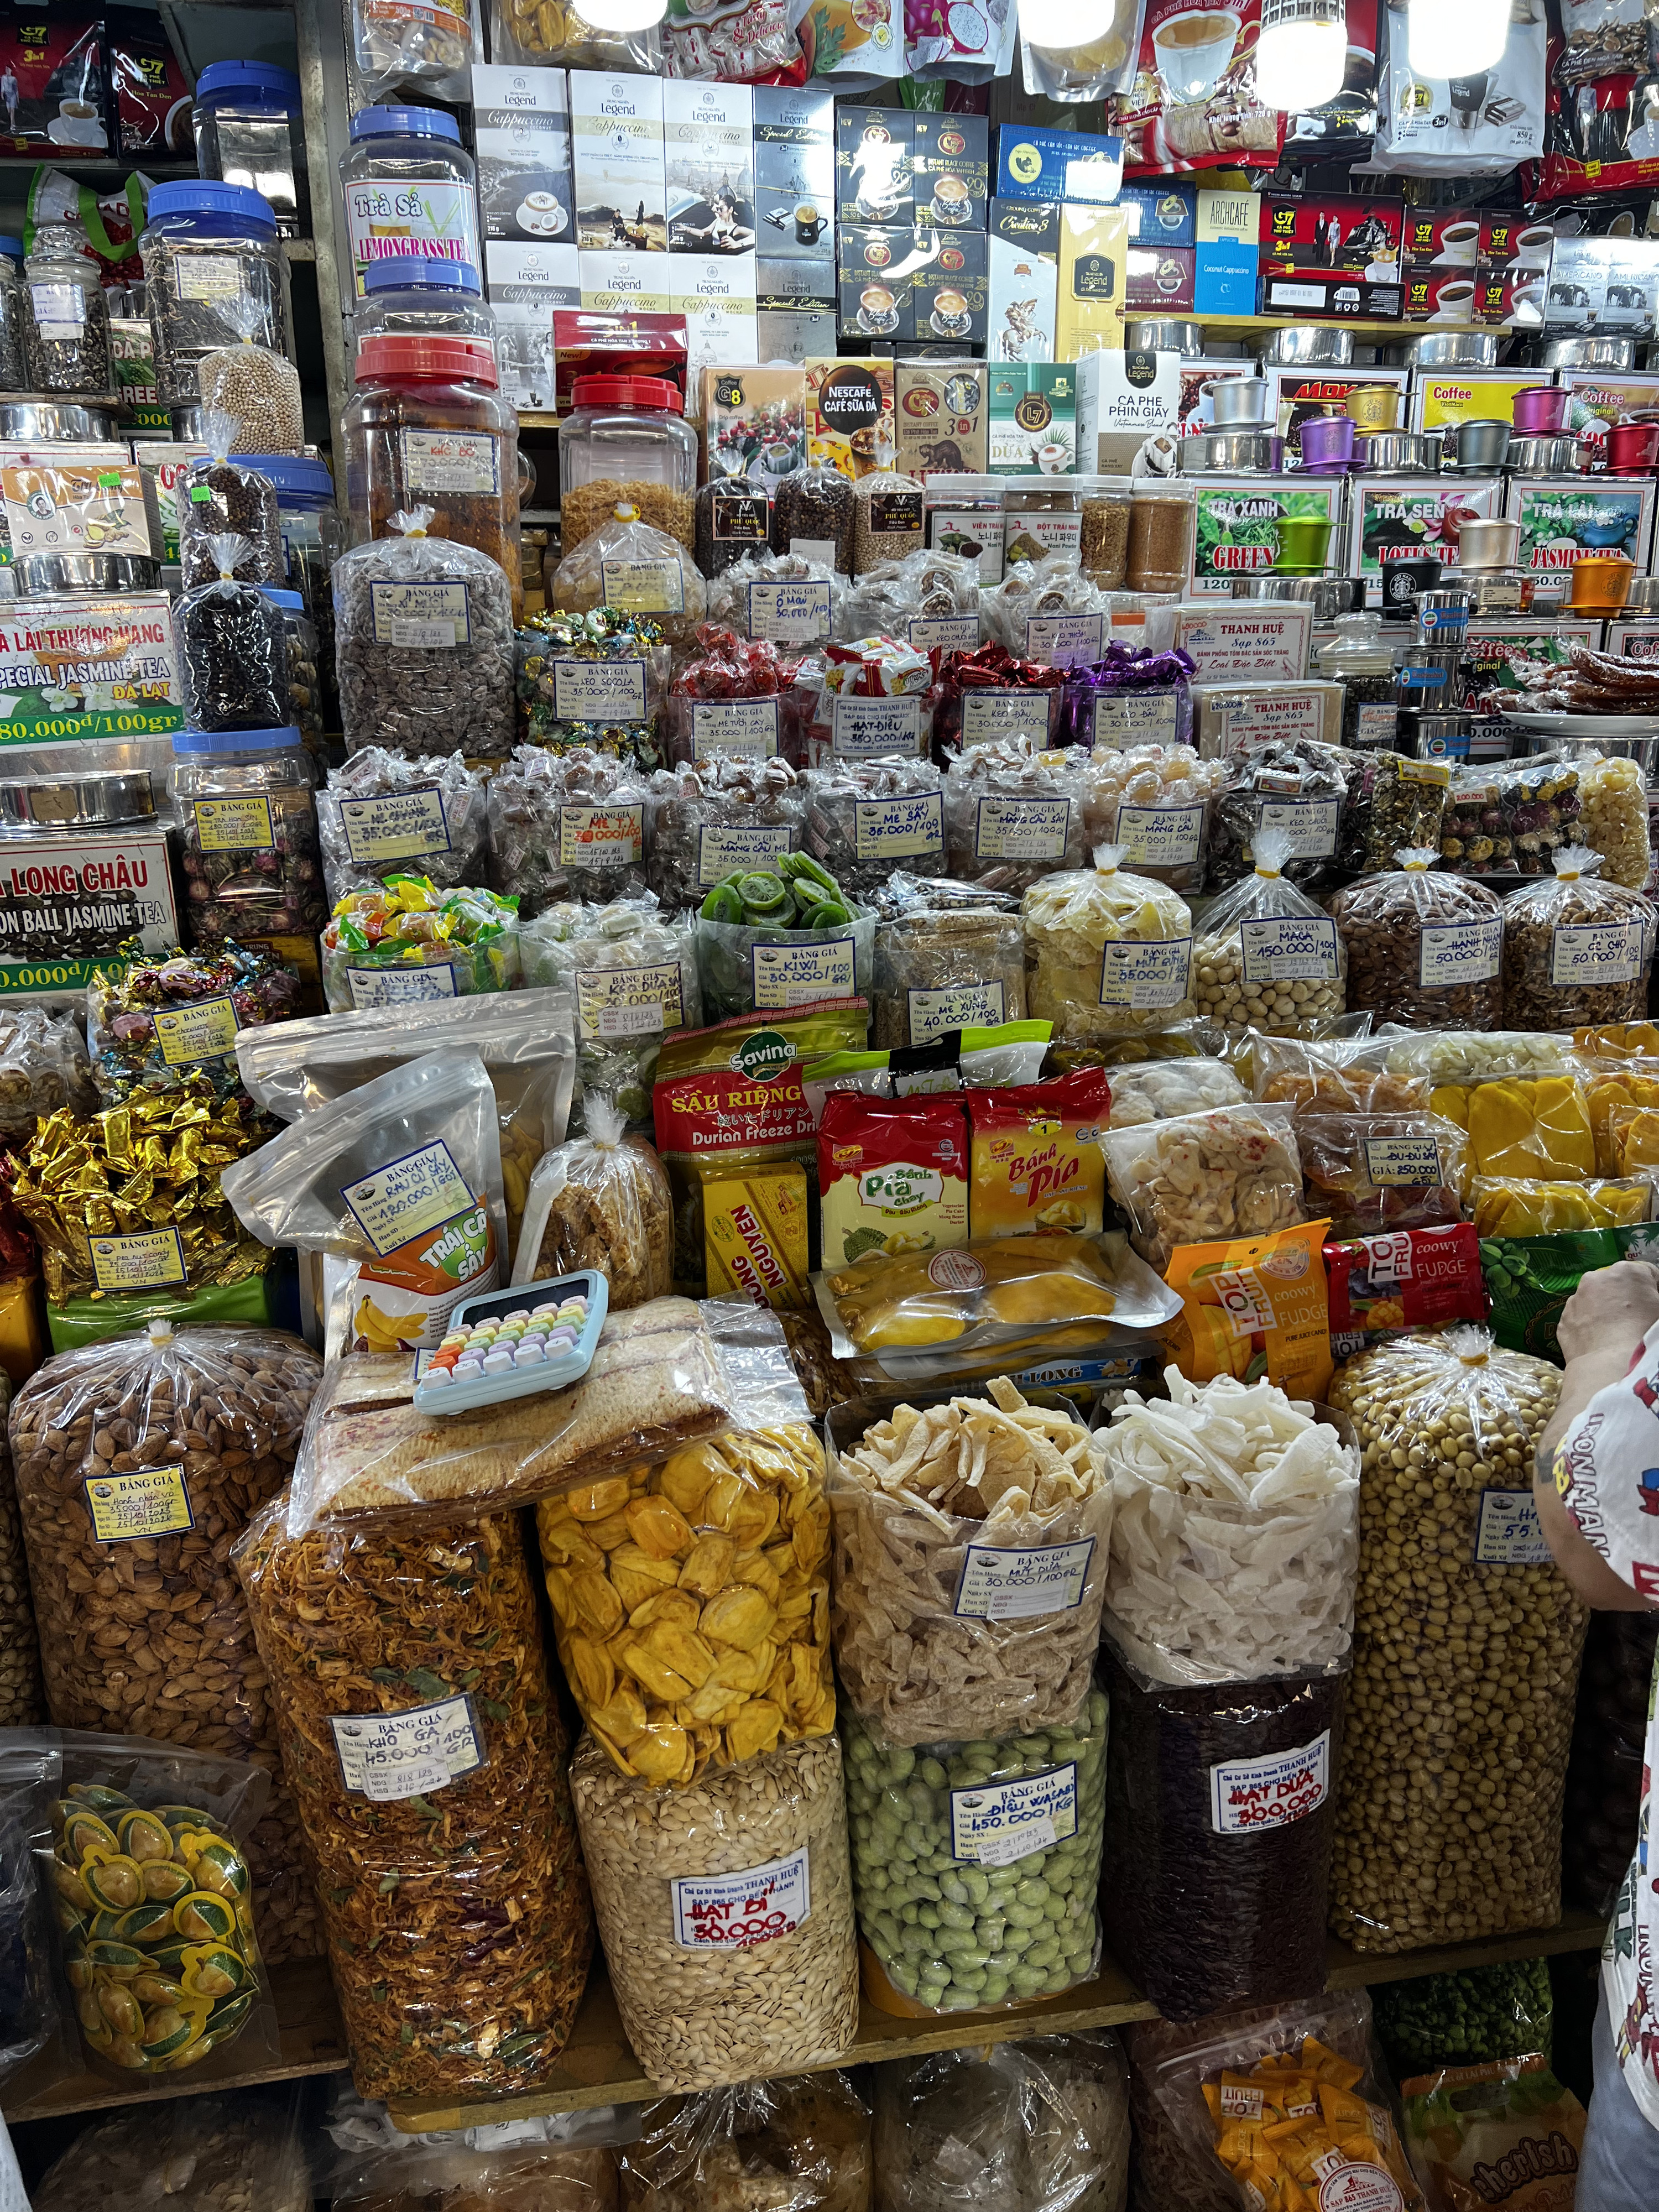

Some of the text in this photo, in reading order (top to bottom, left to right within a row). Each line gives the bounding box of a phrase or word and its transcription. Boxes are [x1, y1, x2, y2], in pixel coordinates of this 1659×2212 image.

[741, 3, 766, 28] Tasty
[732, 21, 786, 45] & Delicious
[504, 95, 537, 107] Legend
[601, 104, 635, 116] Legend
[692, 111, 726, 123] Legend
[487, 110, 553, 128] Cappuccino
[780, 115, 808, 125] Legend
[354, 191, 422, 218] Trà Sả
[1209, 199, 1249, 228] ARCHCAFÉ
[358, 237, 472, 262] LEMONGRASS TEA
[518, 271, 549, 284] Legend
[1203, 263, 1250, 276] Coconut Cappuccino
[1557, 270, 1603, 279] AMERICANO
[608, 279, 641, 292] Legend
[696, 283, 729, 296] Legend
[782, 284, 811, 295] Legend
[1081, 275, 1108, 288] Legend
[503, 285, 567, 306] Cappuccino
[593, 292, 656, 312] Cappuccino
[681, 296, 743, 316] Cappuccino
[560, 351, 583, 359] New!
[1128, 369, 1154, 379] Legend
[718, 385, 741, 405] G8
[828, 383, 873, 399] NESCAFÉ
[1433, 387, 1472, 400] Coffee
[1580, 389, 1624, 405] Coffee
[825, 398, 877, 413] CAFÉ SỮA ĐÁ
[1109, 406, 1139, 416] PHIN
[1026, 407, 1042, 423] L7
[945, 418, 955, 436] 3
[959, 422, 968, 431] in
[1240, 501, 1278, 517] XANH
[1409, 504, 1446, 519] SEN
[1052, 522, 1069, 530] TRÁI
[1213, 546, 1275, 570] GREEN
[1221, 622, 1284, 635] THANH HUỆ
[14, 623, 164, 652] LÀI THƯỢNG HẠNG
[1232, 638, 1276, 648] Sạp 865
[588, 666, 629, 675] BẢNG GIÁ
[1208, 660, 1229, 670] Loại
[58, 657, 171, 690] JASMINE TEA
[113, 682, 170, 701] ĐÀ LẠT
[1255, 699, 1312, 713] THANH HUỆ
[1264, 713, 1281, 723] Sạp
[375, 796, 424, 812] BẢNG GIÁ
[1455, 792, 1485, 802] 200.000
[221, 800, 262, 811] BẢNG GIÁ
[884, 815, 900, 824] ME
[11, 854, 149, 895] LONG CHÂU
[23, 900, 166, 936] BALL JASMINE TEA
[1279, 932, 1314, 942] MACA
[791, 947, 838, 961] BẢNG GIÁ
[784, 960, 818, 972] KIWI
[939, 1005, 953, 1015] ME
[729, 1041, 797, 1072] Savina
[671, 1085, 802, 1113] SẦU RIÊNG
[692, 1124, 793, 1145] Durian Freeze
[386, 1152, 433, 1184] BẢNG GIÁ
[1007, 1141, 1057, 1183] Bánh
[894, 1168, 933, 1180] Bánh
[1027, 1156, 1079, 1208] Pía
[121, 1233, 170, 1249] BẢNG GIÁ
[419, 1222, 463, 1270] TRÁI
[1416, 1239, 1461, 1254] coowy
[457, 1244, 487, 1282] SẤY
[1417, 1259, 1467, 1277] FUDGE
[1224, 1275, 1251, 1329] TOP
[1274, 1285, 1318, 1304] coowy
[1279, 1303, 1328, 1327] FUDGE
[1044, 1365, 1083, 1383] LONG
[119, 1473, 174, 1492] BẢNG GIÁ
[1017, 1548, 1071, 1567] BẢNG GIÁ
[378, 1710, 442, 1734] BẢNG GIÁ
[1279, 1745, 1321, 1773] THANH HUỆ
[1000, 1777, 1056, 1800] BẢNG GIÁ
[744, 1865, 799, 1890] THANH HUỆ
[1357, 2189, 1379, 2199] THANH
